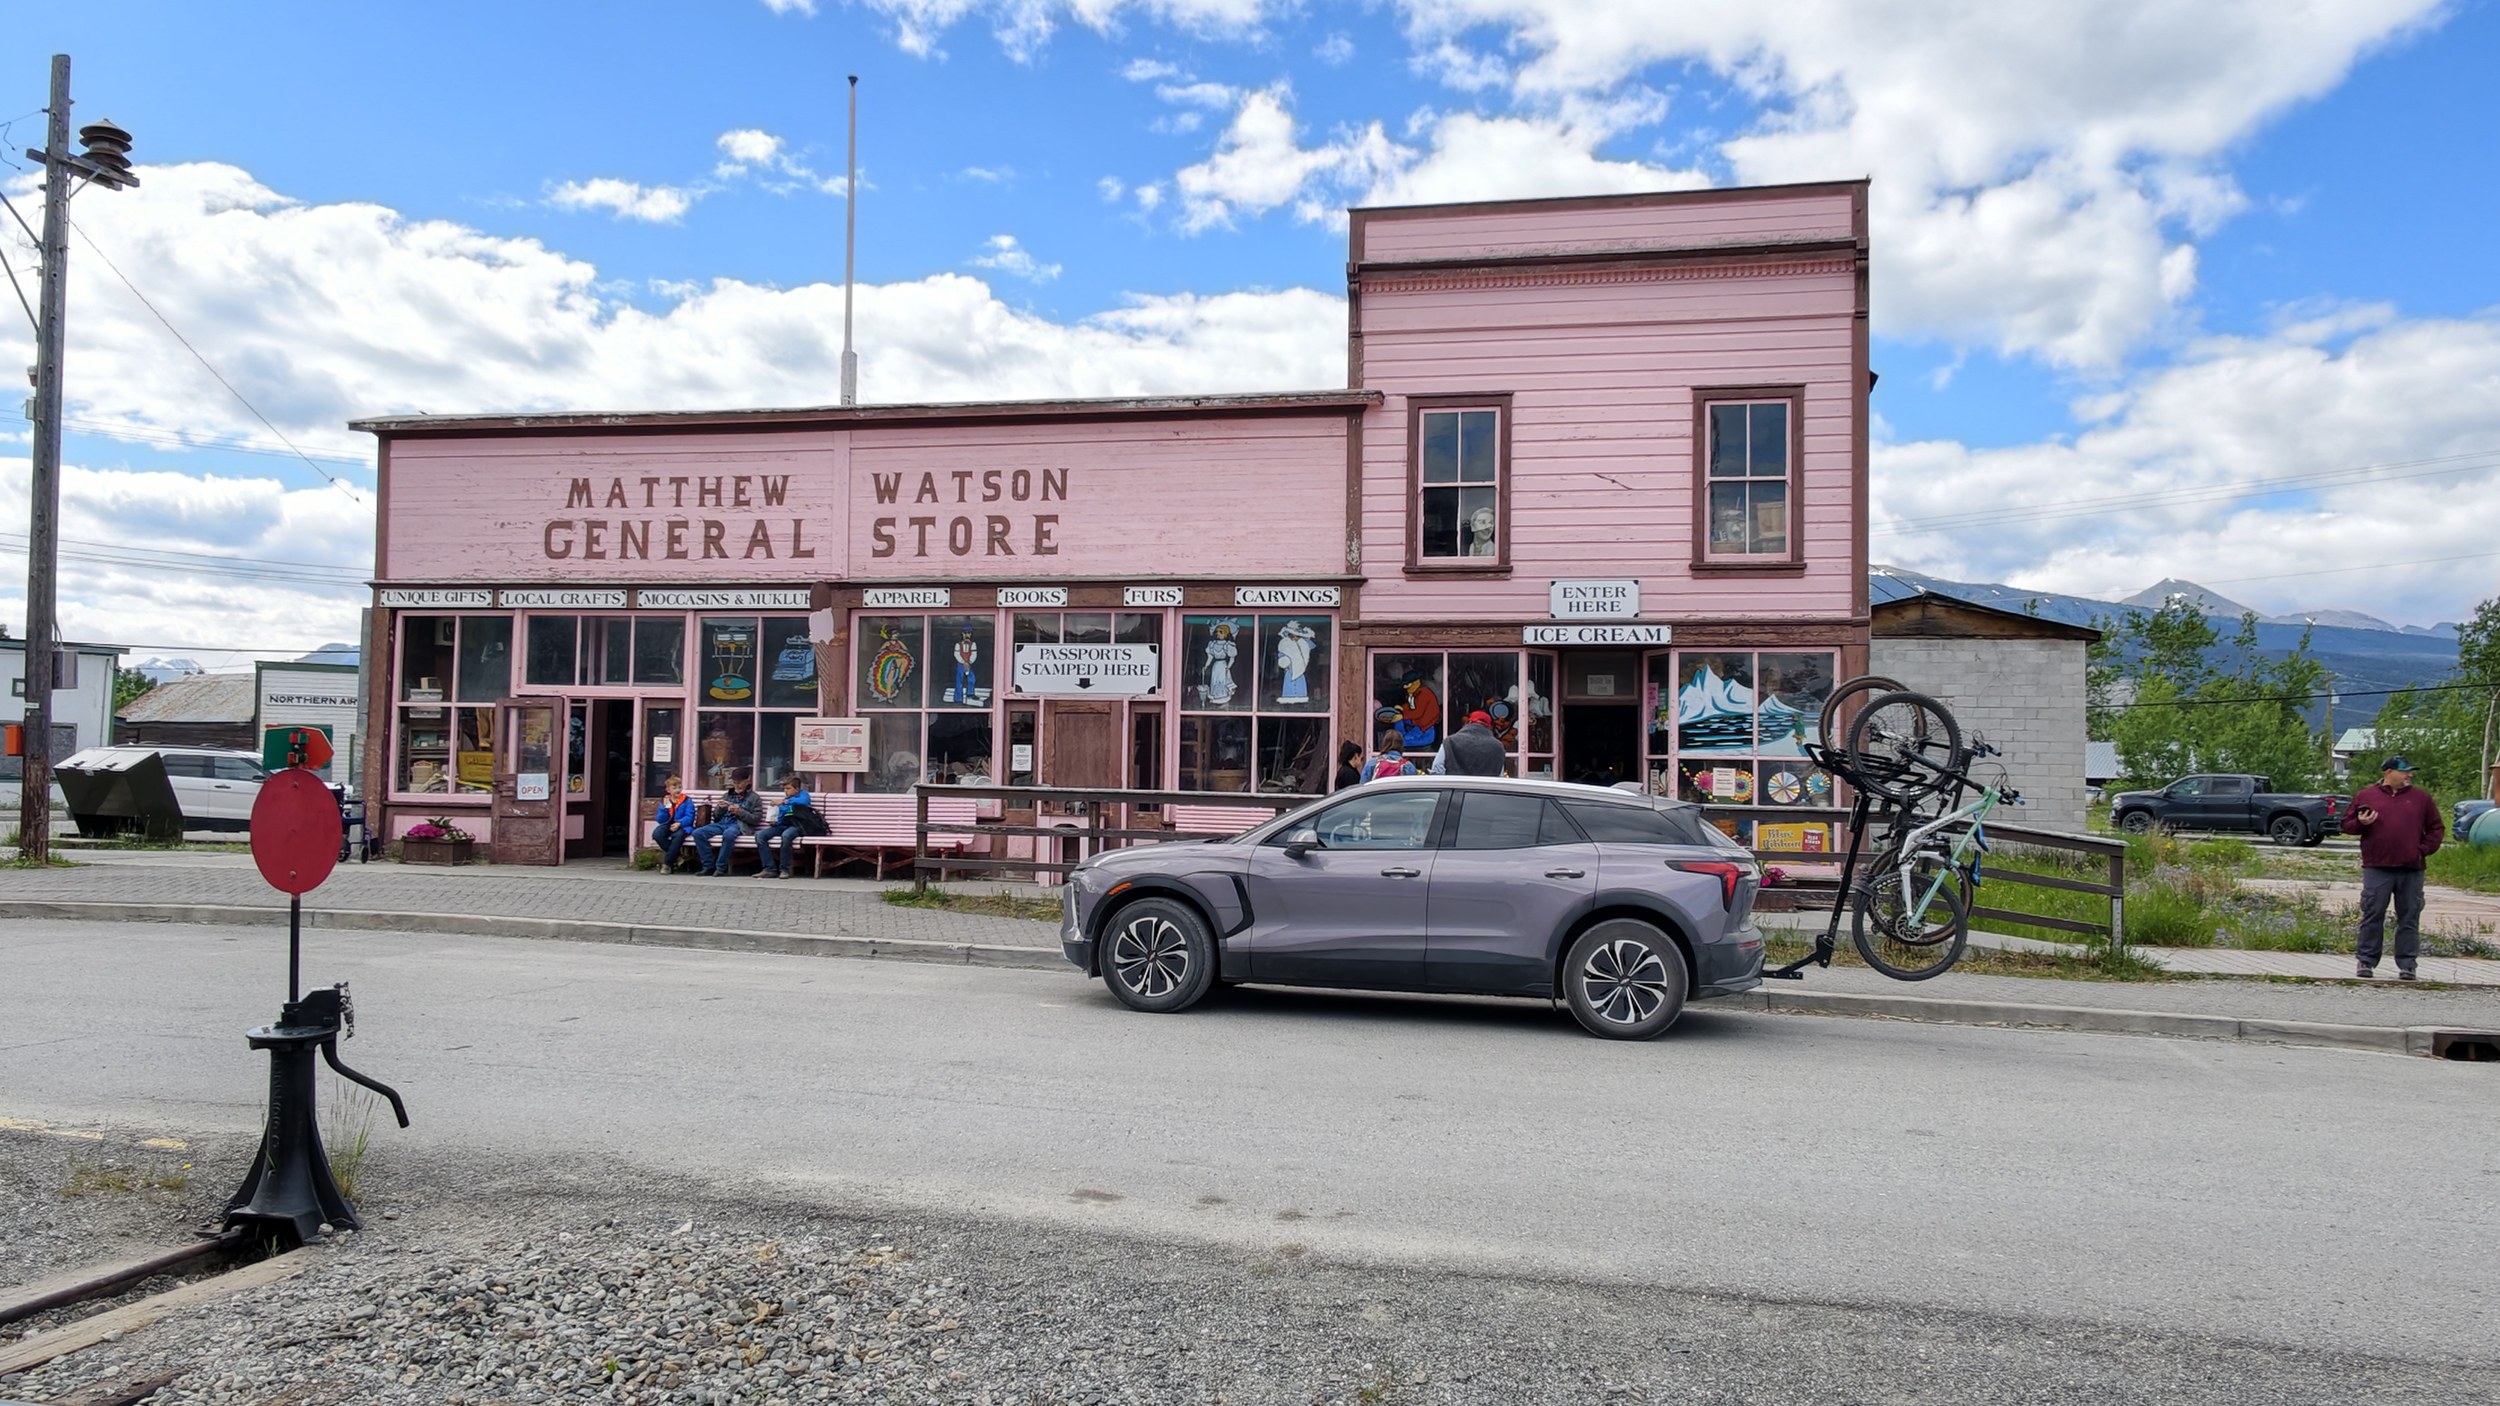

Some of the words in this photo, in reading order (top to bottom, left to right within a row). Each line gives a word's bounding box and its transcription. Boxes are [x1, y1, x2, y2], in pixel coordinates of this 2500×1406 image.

[565, 475, 790, 508] MATTHEW
[872, 468, 1070, 504] WATSON
[544, 518, 816, 560] GENERAL
[872, 514, 1060, 558] STORE
[386, 591, 441, 604] UNIQUE
[444, 591, 487, 603] GIFTS
[869, 591, 943, 604] APPAREL
[1004, 590, 1062, 603] BOOKS
[1131, 590, 1176, 603] FURS
[1242, 590, 1334, 603] CARVINGS
[1562, 586, 1627, 598] ENTER
[505, 593, 556, 605] LOCAL
[560, 593, 621, 605] CRAFTS
[643, 593, 729, 605] MOCCASINS
[734, 594, 744, 605] &
[1568, 601, 1622, 613] HERE
[1533, 627, 1569, 642] ICE
[1578, 627, 1664, 642] CREAM
[1039, 648, 1132, 661] PASSPORTS
[1021, 663, 1099, 676] STAMPED
[1104, 663, 1151, 676] HERE
[269, 695, 337, 705] NORTHERN
[521, 785, 544, 795] OPEN
